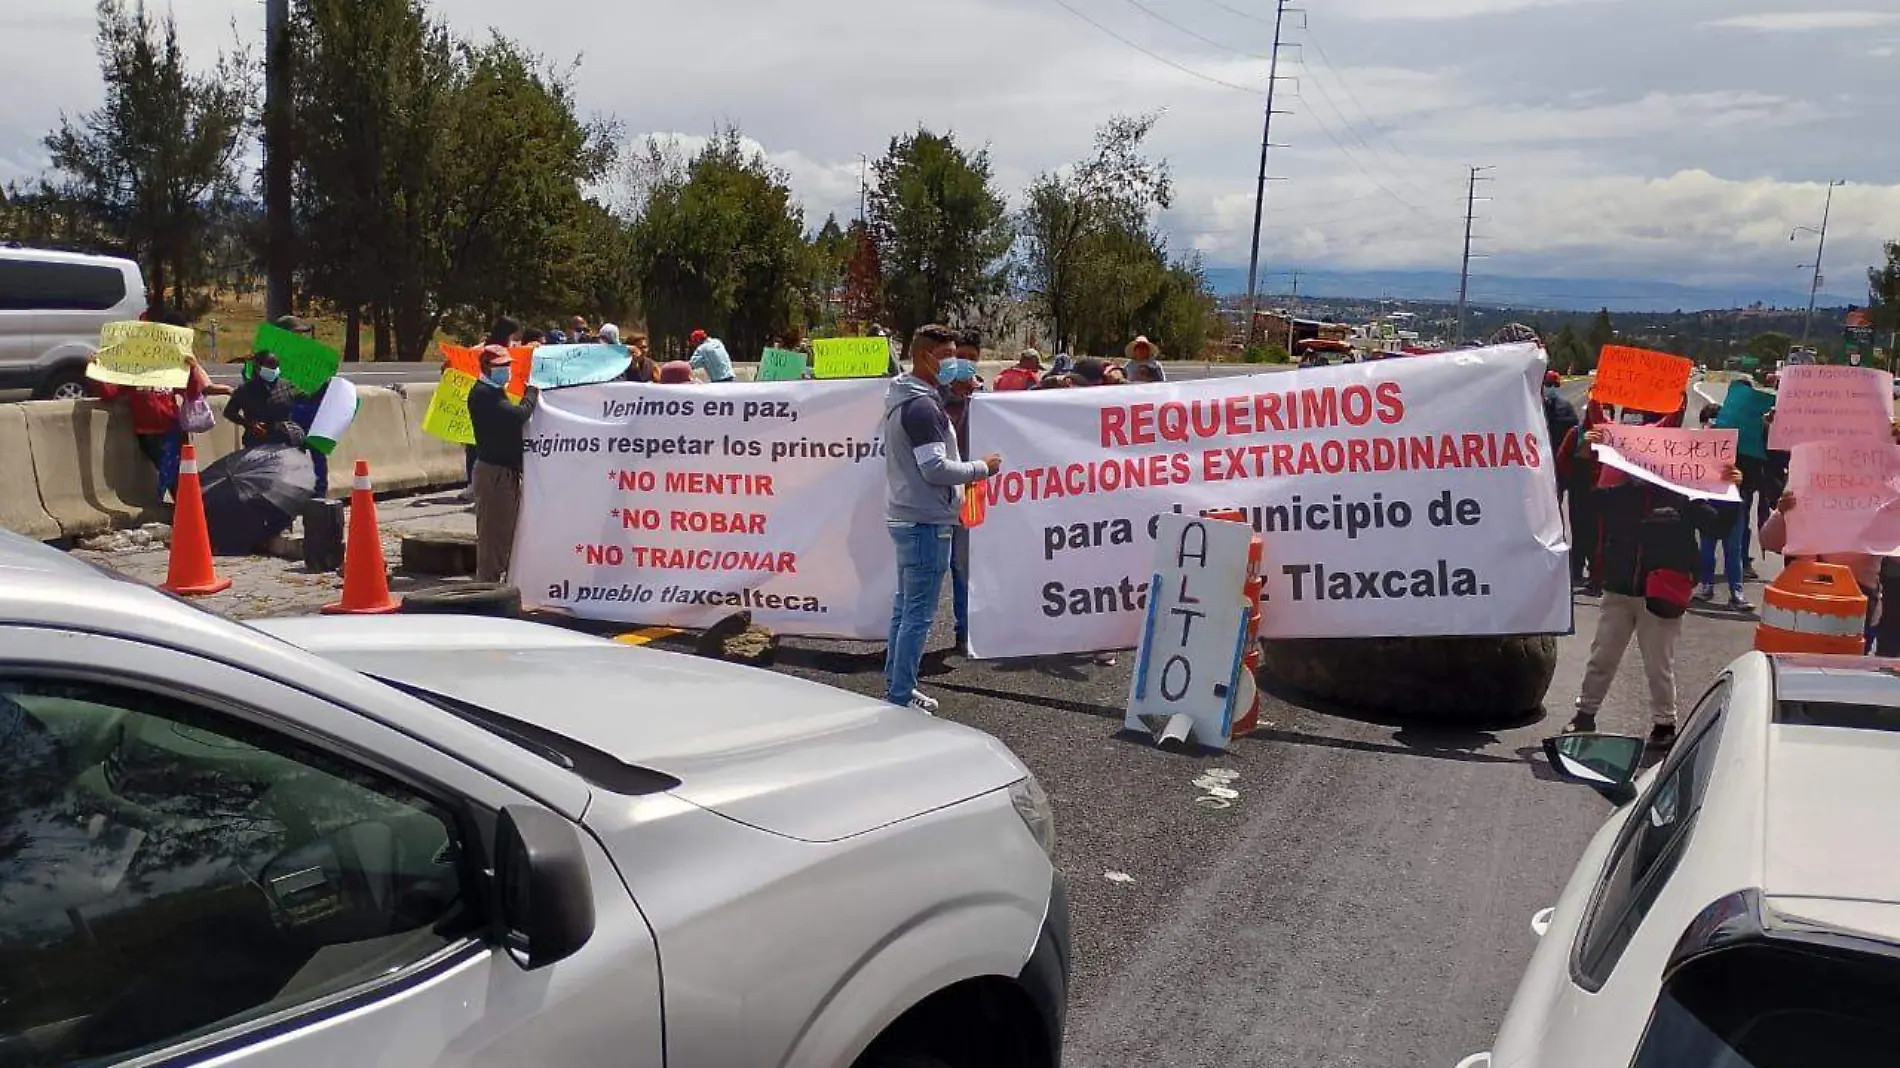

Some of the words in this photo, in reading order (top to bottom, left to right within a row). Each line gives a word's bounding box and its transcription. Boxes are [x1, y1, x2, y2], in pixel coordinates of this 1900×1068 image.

[602, 396, 694, 418] Venimos
[703, 400, 734, 416] en
[743, 401, 799, 422] paz,
[1100, 382, 1405, 448] REQUERIMOS
[608, 434, 714, 458] respetar
[723, 435, 761, 457] los
[665, 471, 774, 496] MENTIR
[985, 452, 1192, 507] VOTACIONES
[1203, 432, 1541, 482] EXTRAORDINARIAS
[670, 511, 767, 535] ROBAR
[1044, 518, 1132, 560] para
[1200, 492, 1412, 539] unicipio
[1428, 490, 1482, 527] de
[632, 546, 796, 573] TRAICIONAR
[549, 580, 569, 600] al
[574, 583, 654, 603] pueblo
[661, 585, 829, 614] tlaxcalteca.
[1282, 559, 1491, 601] Tlaxcala.
[1160, 521, 1206, 703] ALTO
